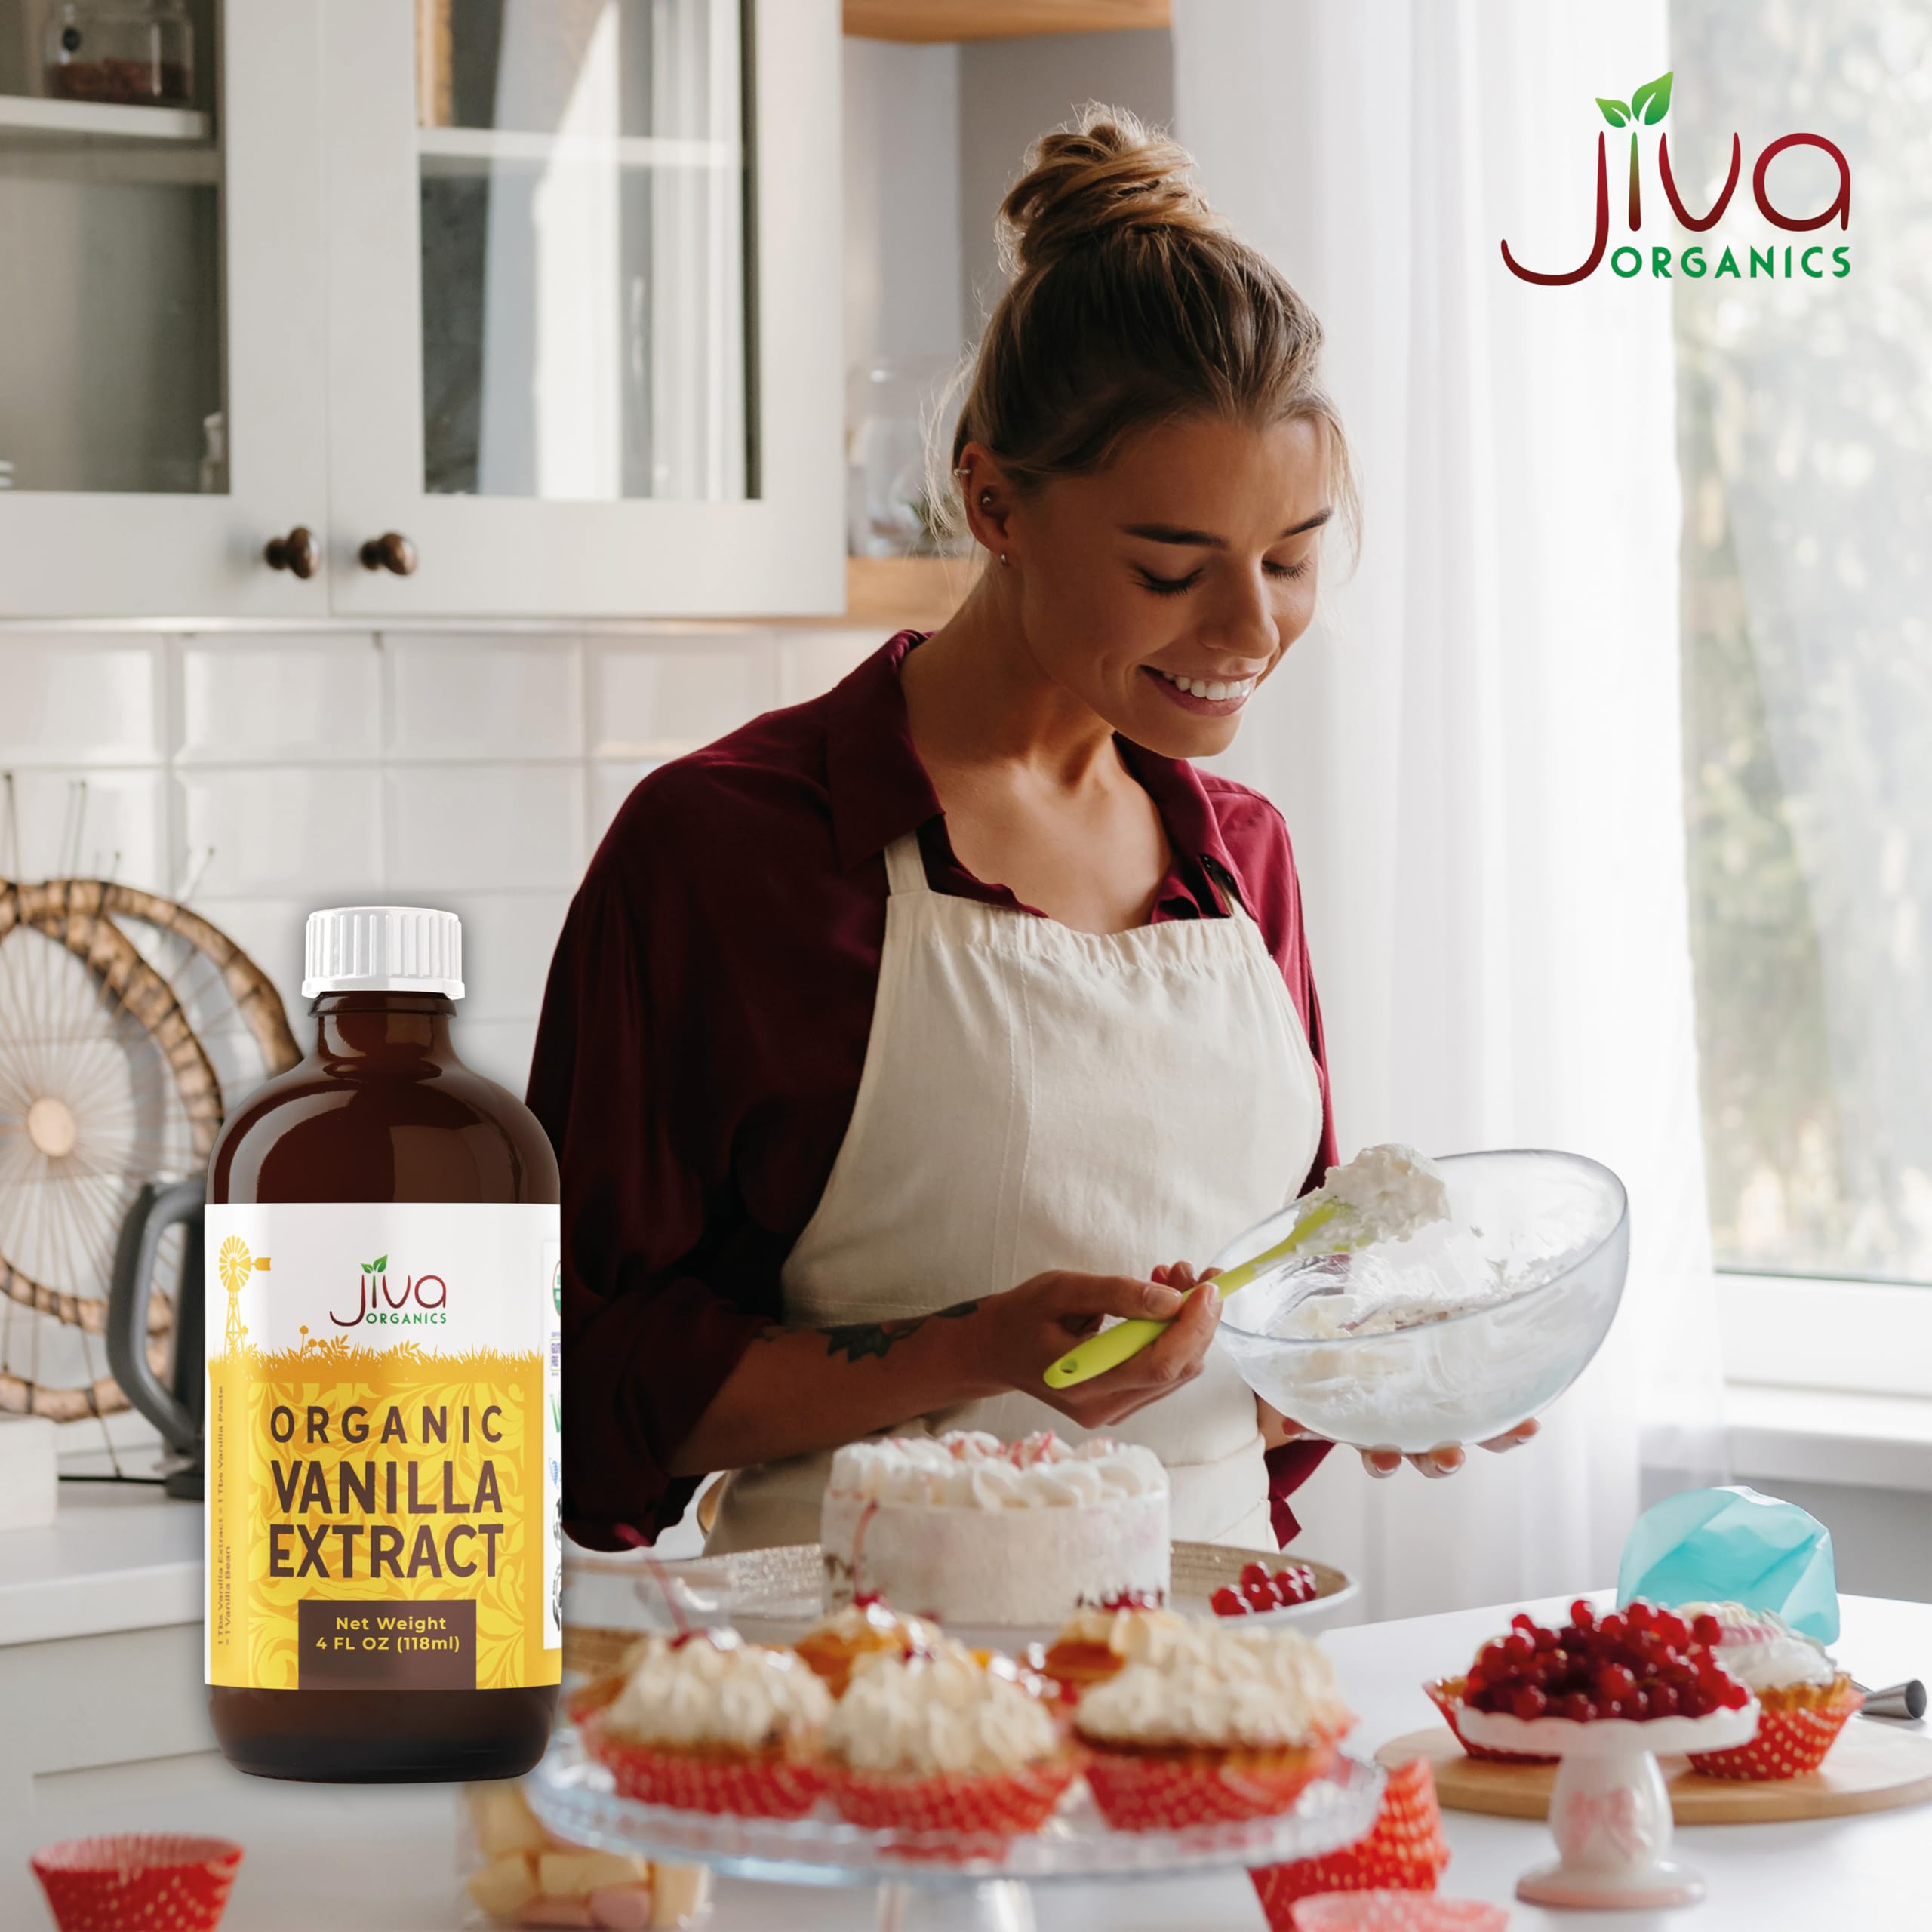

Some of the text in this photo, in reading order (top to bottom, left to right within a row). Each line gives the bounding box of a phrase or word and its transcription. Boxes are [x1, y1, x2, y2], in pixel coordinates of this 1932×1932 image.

[366, 1312, 447, 1324] ORGANICS
[270, 1405, 503, 1444] ORGANIC
[270, 1460, 503, 1514] VANILLA
[269, 1524, 504, 1578] EXTRACT
[337, 1616, 447, 1633] Net Weight
[316, 1636, 460, 1654] 4 FL OZ (118ml)
